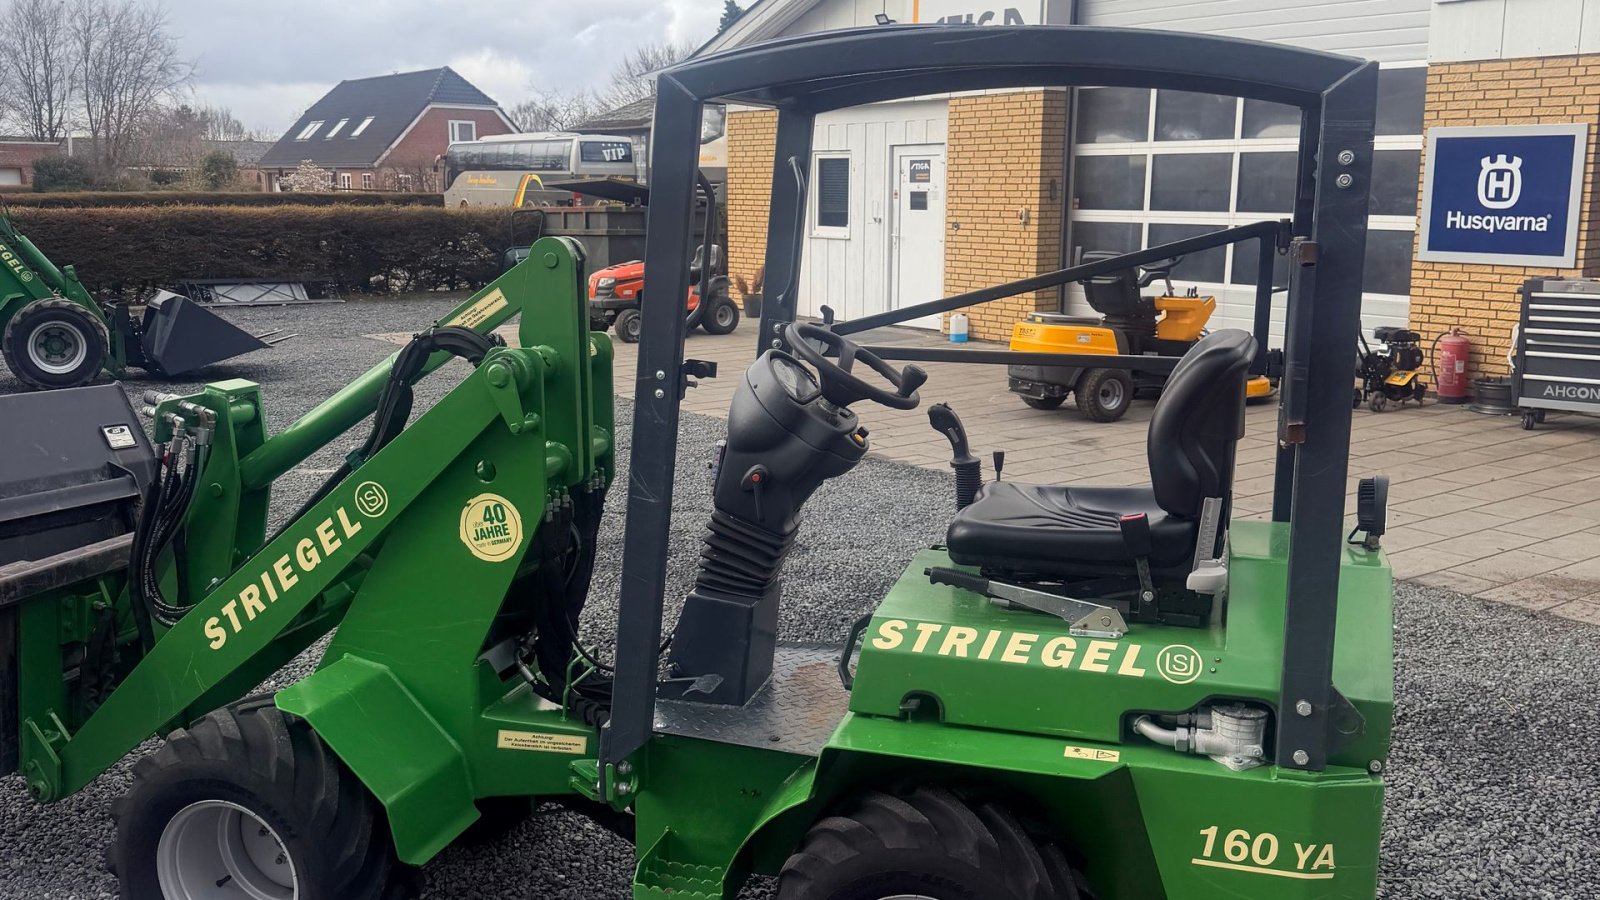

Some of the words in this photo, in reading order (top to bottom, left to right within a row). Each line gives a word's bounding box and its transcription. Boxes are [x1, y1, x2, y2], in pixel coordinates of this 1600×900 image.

[601, 147, 625, 161] VIP
[1446, 210, 1549, 233] Husqvarna
[483, 503, 506, 524] 40
[473, 523, 510, 541] JAHRE
[491, 537, 512, 546] GERMANY
[204, 506, 362, 650] STRIEGEL
[871, 619, 1147, 677] STRIEGEL
[1200, 825, 1279, 866] 160
[1293, 843, 1336, 870] YA
